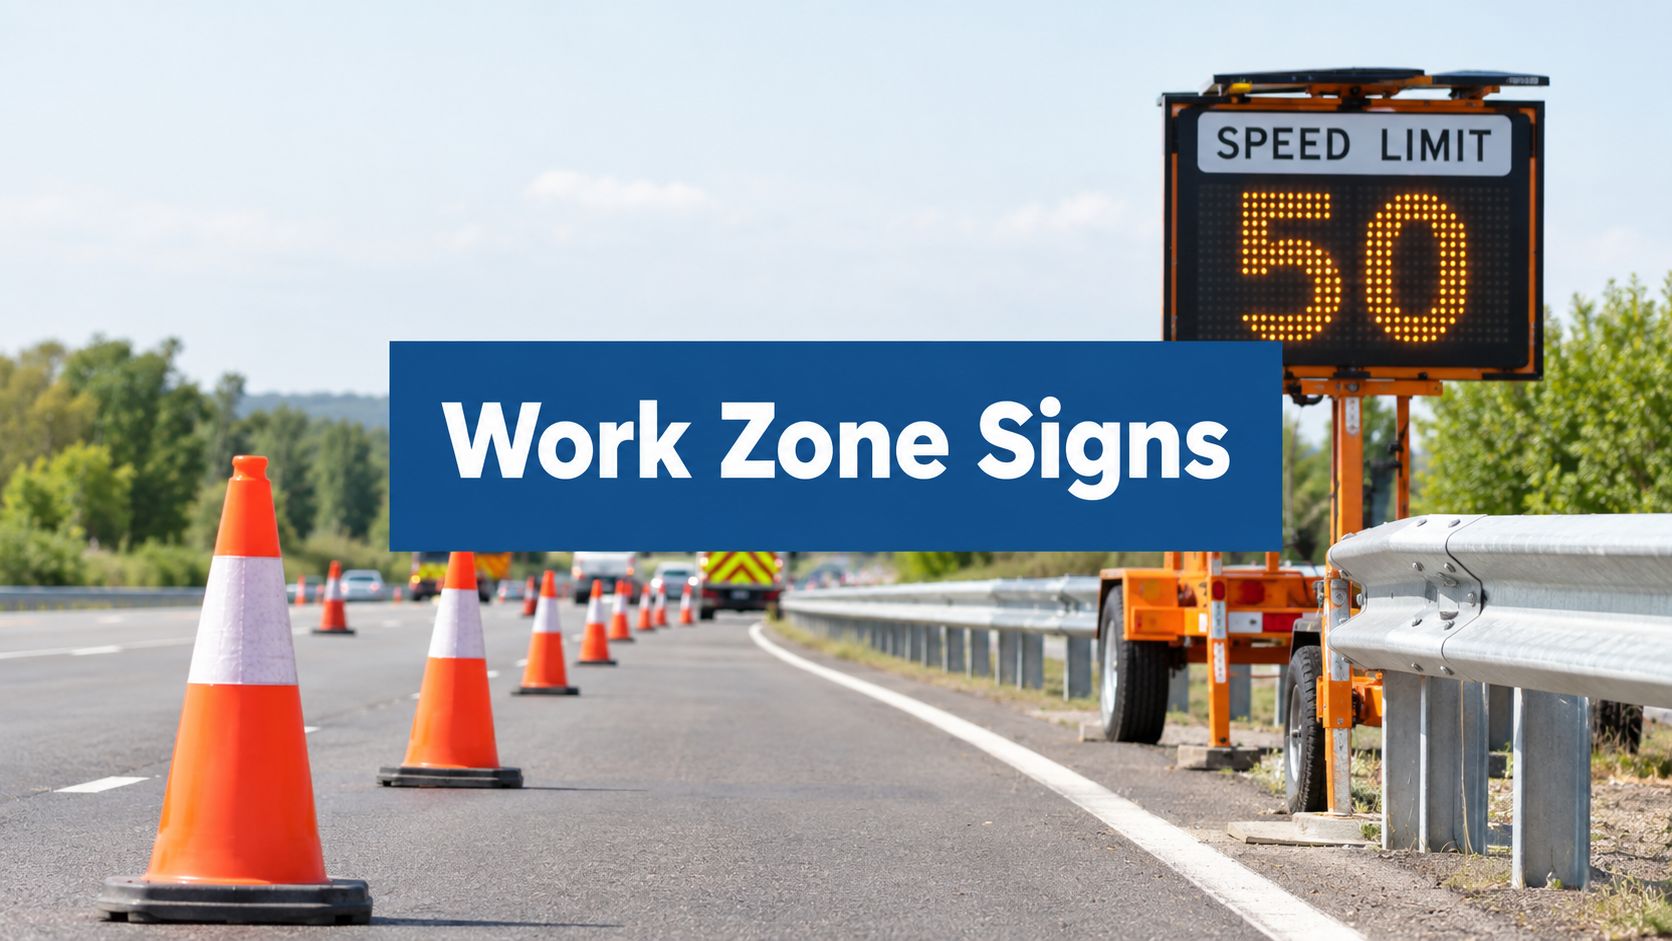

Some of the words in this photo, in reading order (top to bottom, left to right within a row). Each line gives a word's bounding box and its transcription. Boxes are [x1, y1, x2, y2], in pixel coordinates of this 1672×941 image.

[1217, 126, 1351, 161] SPEED
[1381, 128, 1492, 162] LIMIT
[1242, 191, 1467, 343] 50
